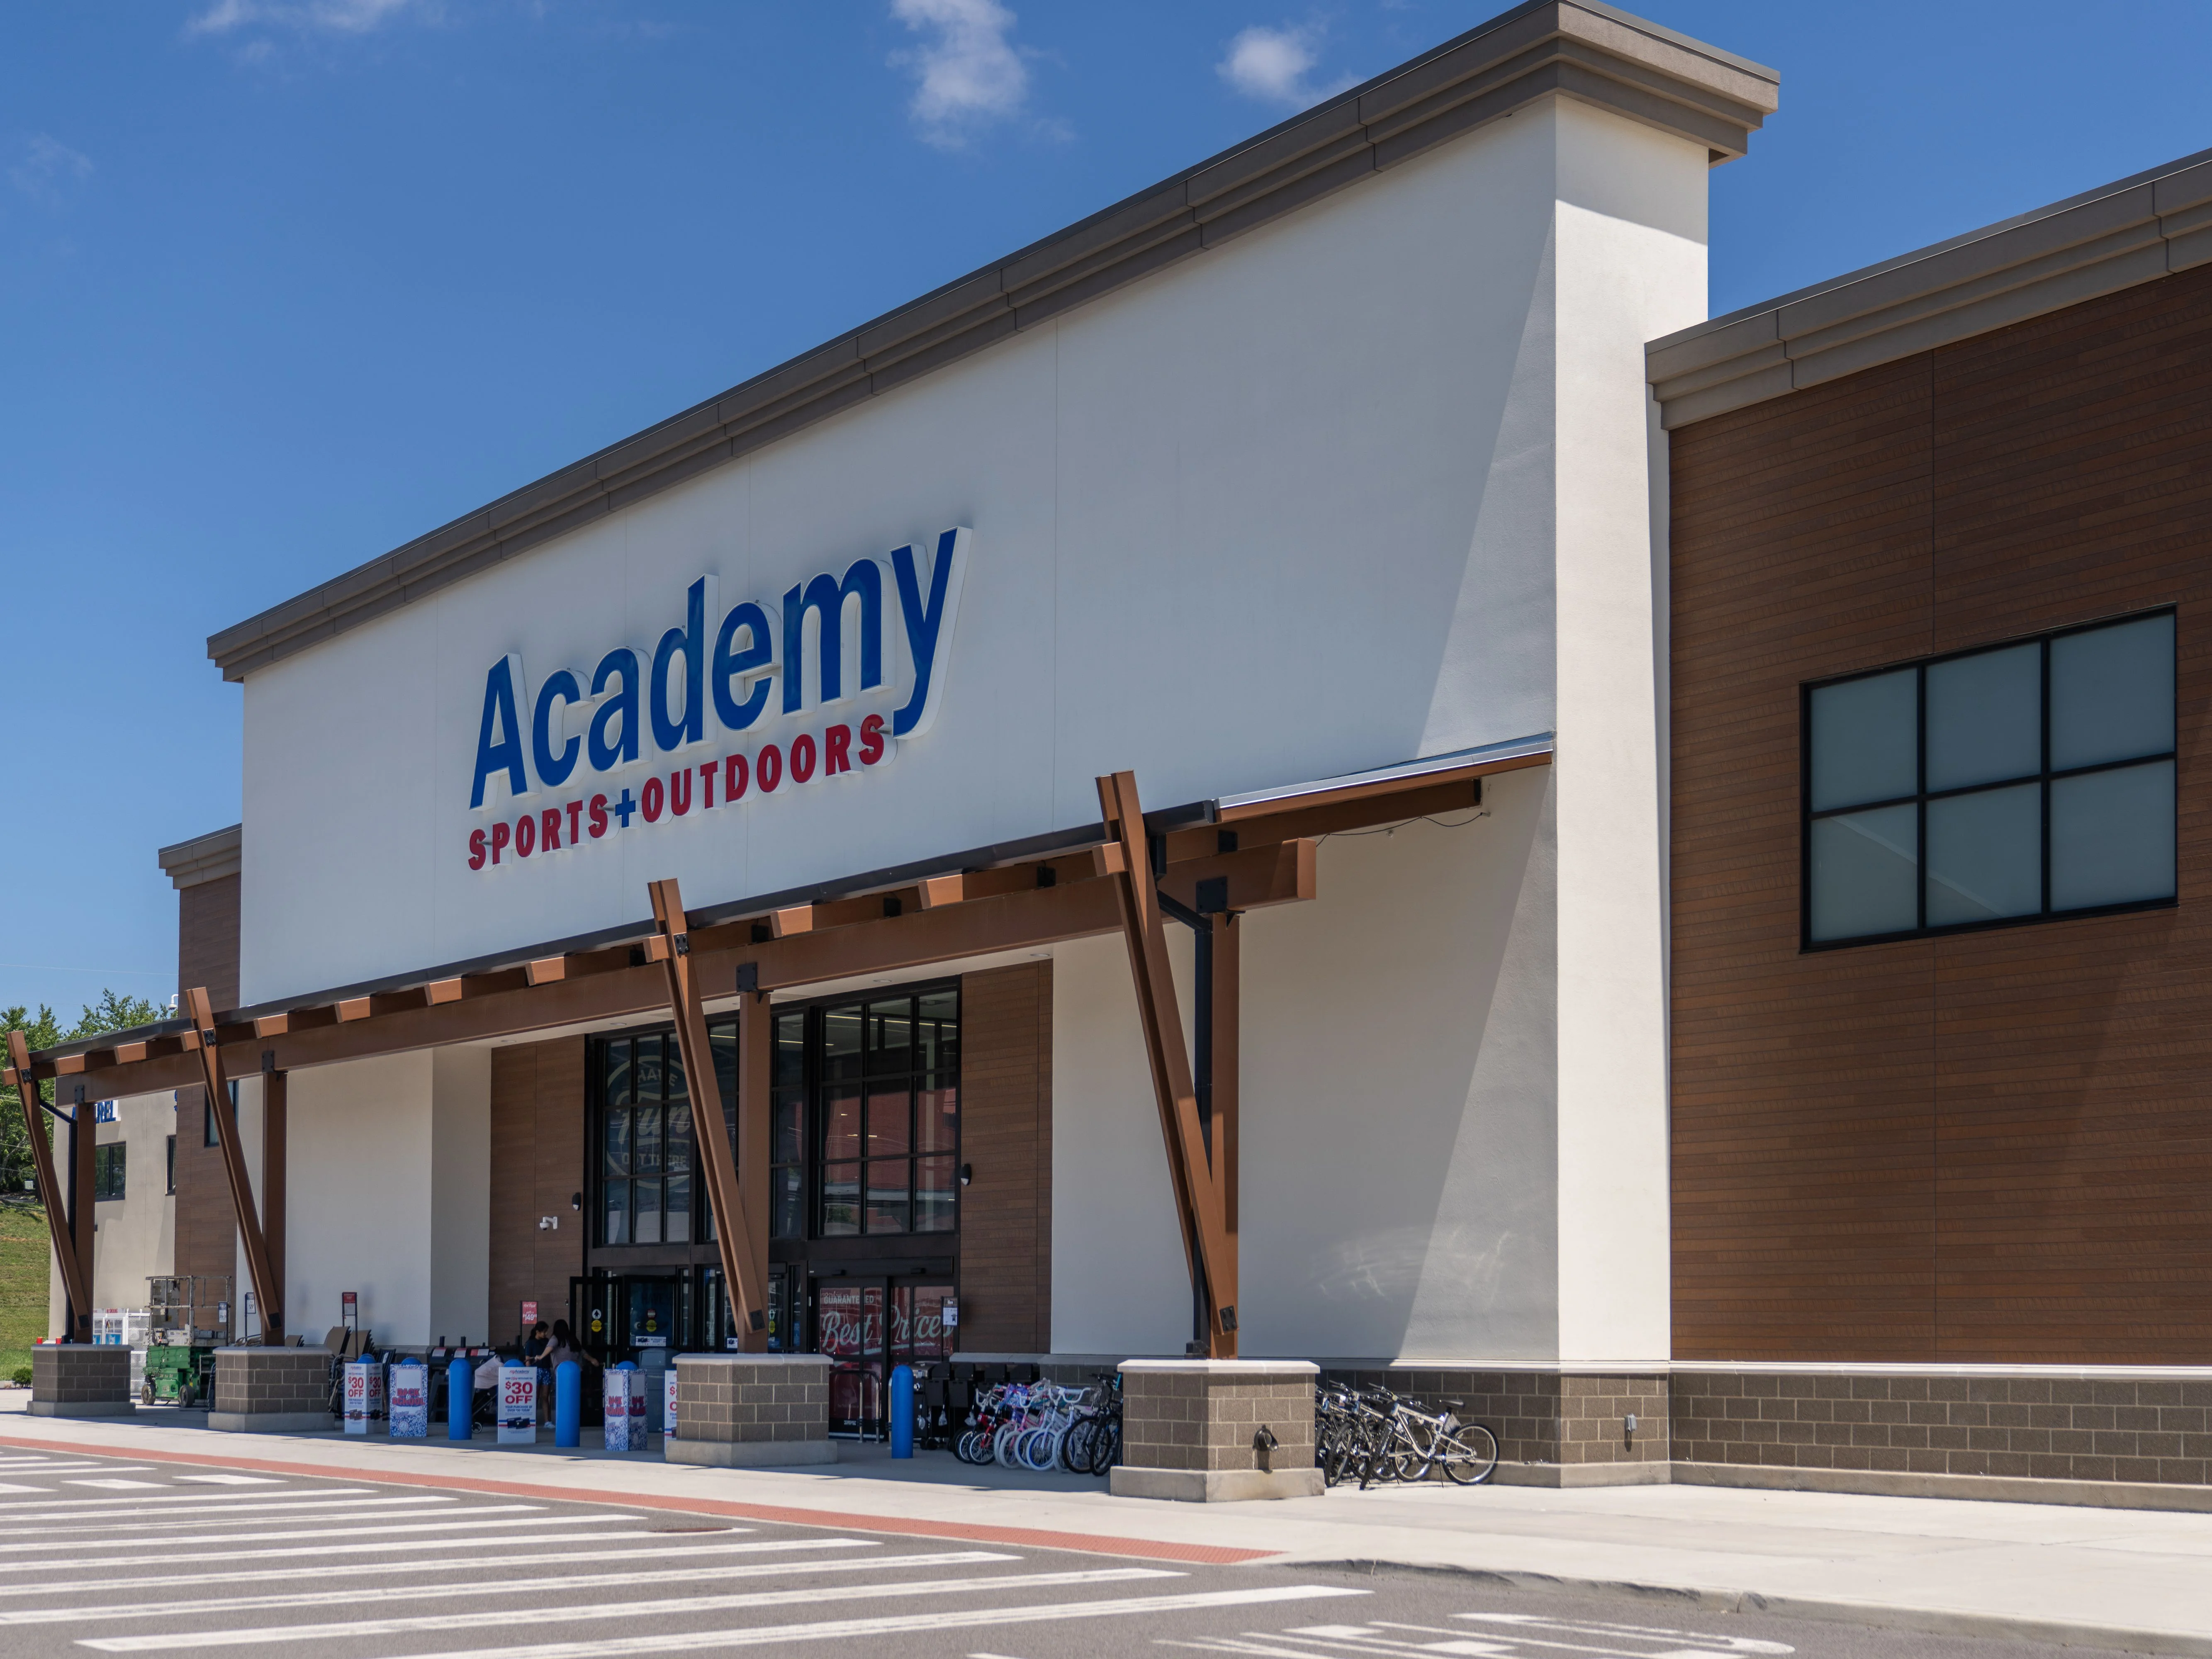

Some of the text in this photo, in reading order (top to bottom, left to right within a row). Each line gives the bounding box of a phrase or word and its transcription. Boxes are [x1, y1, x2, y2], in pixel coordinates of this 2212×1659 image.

[469, 526, 971, 810] Academy
[468, 713, 888, 871] SPORTS+OUTDOORS
[616, 1090, 690, 1145] Fun
[622, 1153, 647, 1165] OT
[824, 1294, 874, 1304] GUARANTEED
[822, 1311, 873, 1352] Best
[348, 1376, 364, 1389] $30
[370, 1376, 381, 1388] $30
[505, 1381, 533, 1394] $30
[348, 1389, 364, 1397] OFF
[369, 1389, 381, 1397] OFF
[397, 1388, 420, 1397] BACK
[392, 1396, 425, 1406] SCHOOL
[505, 1395, 533, 1404] OFF
